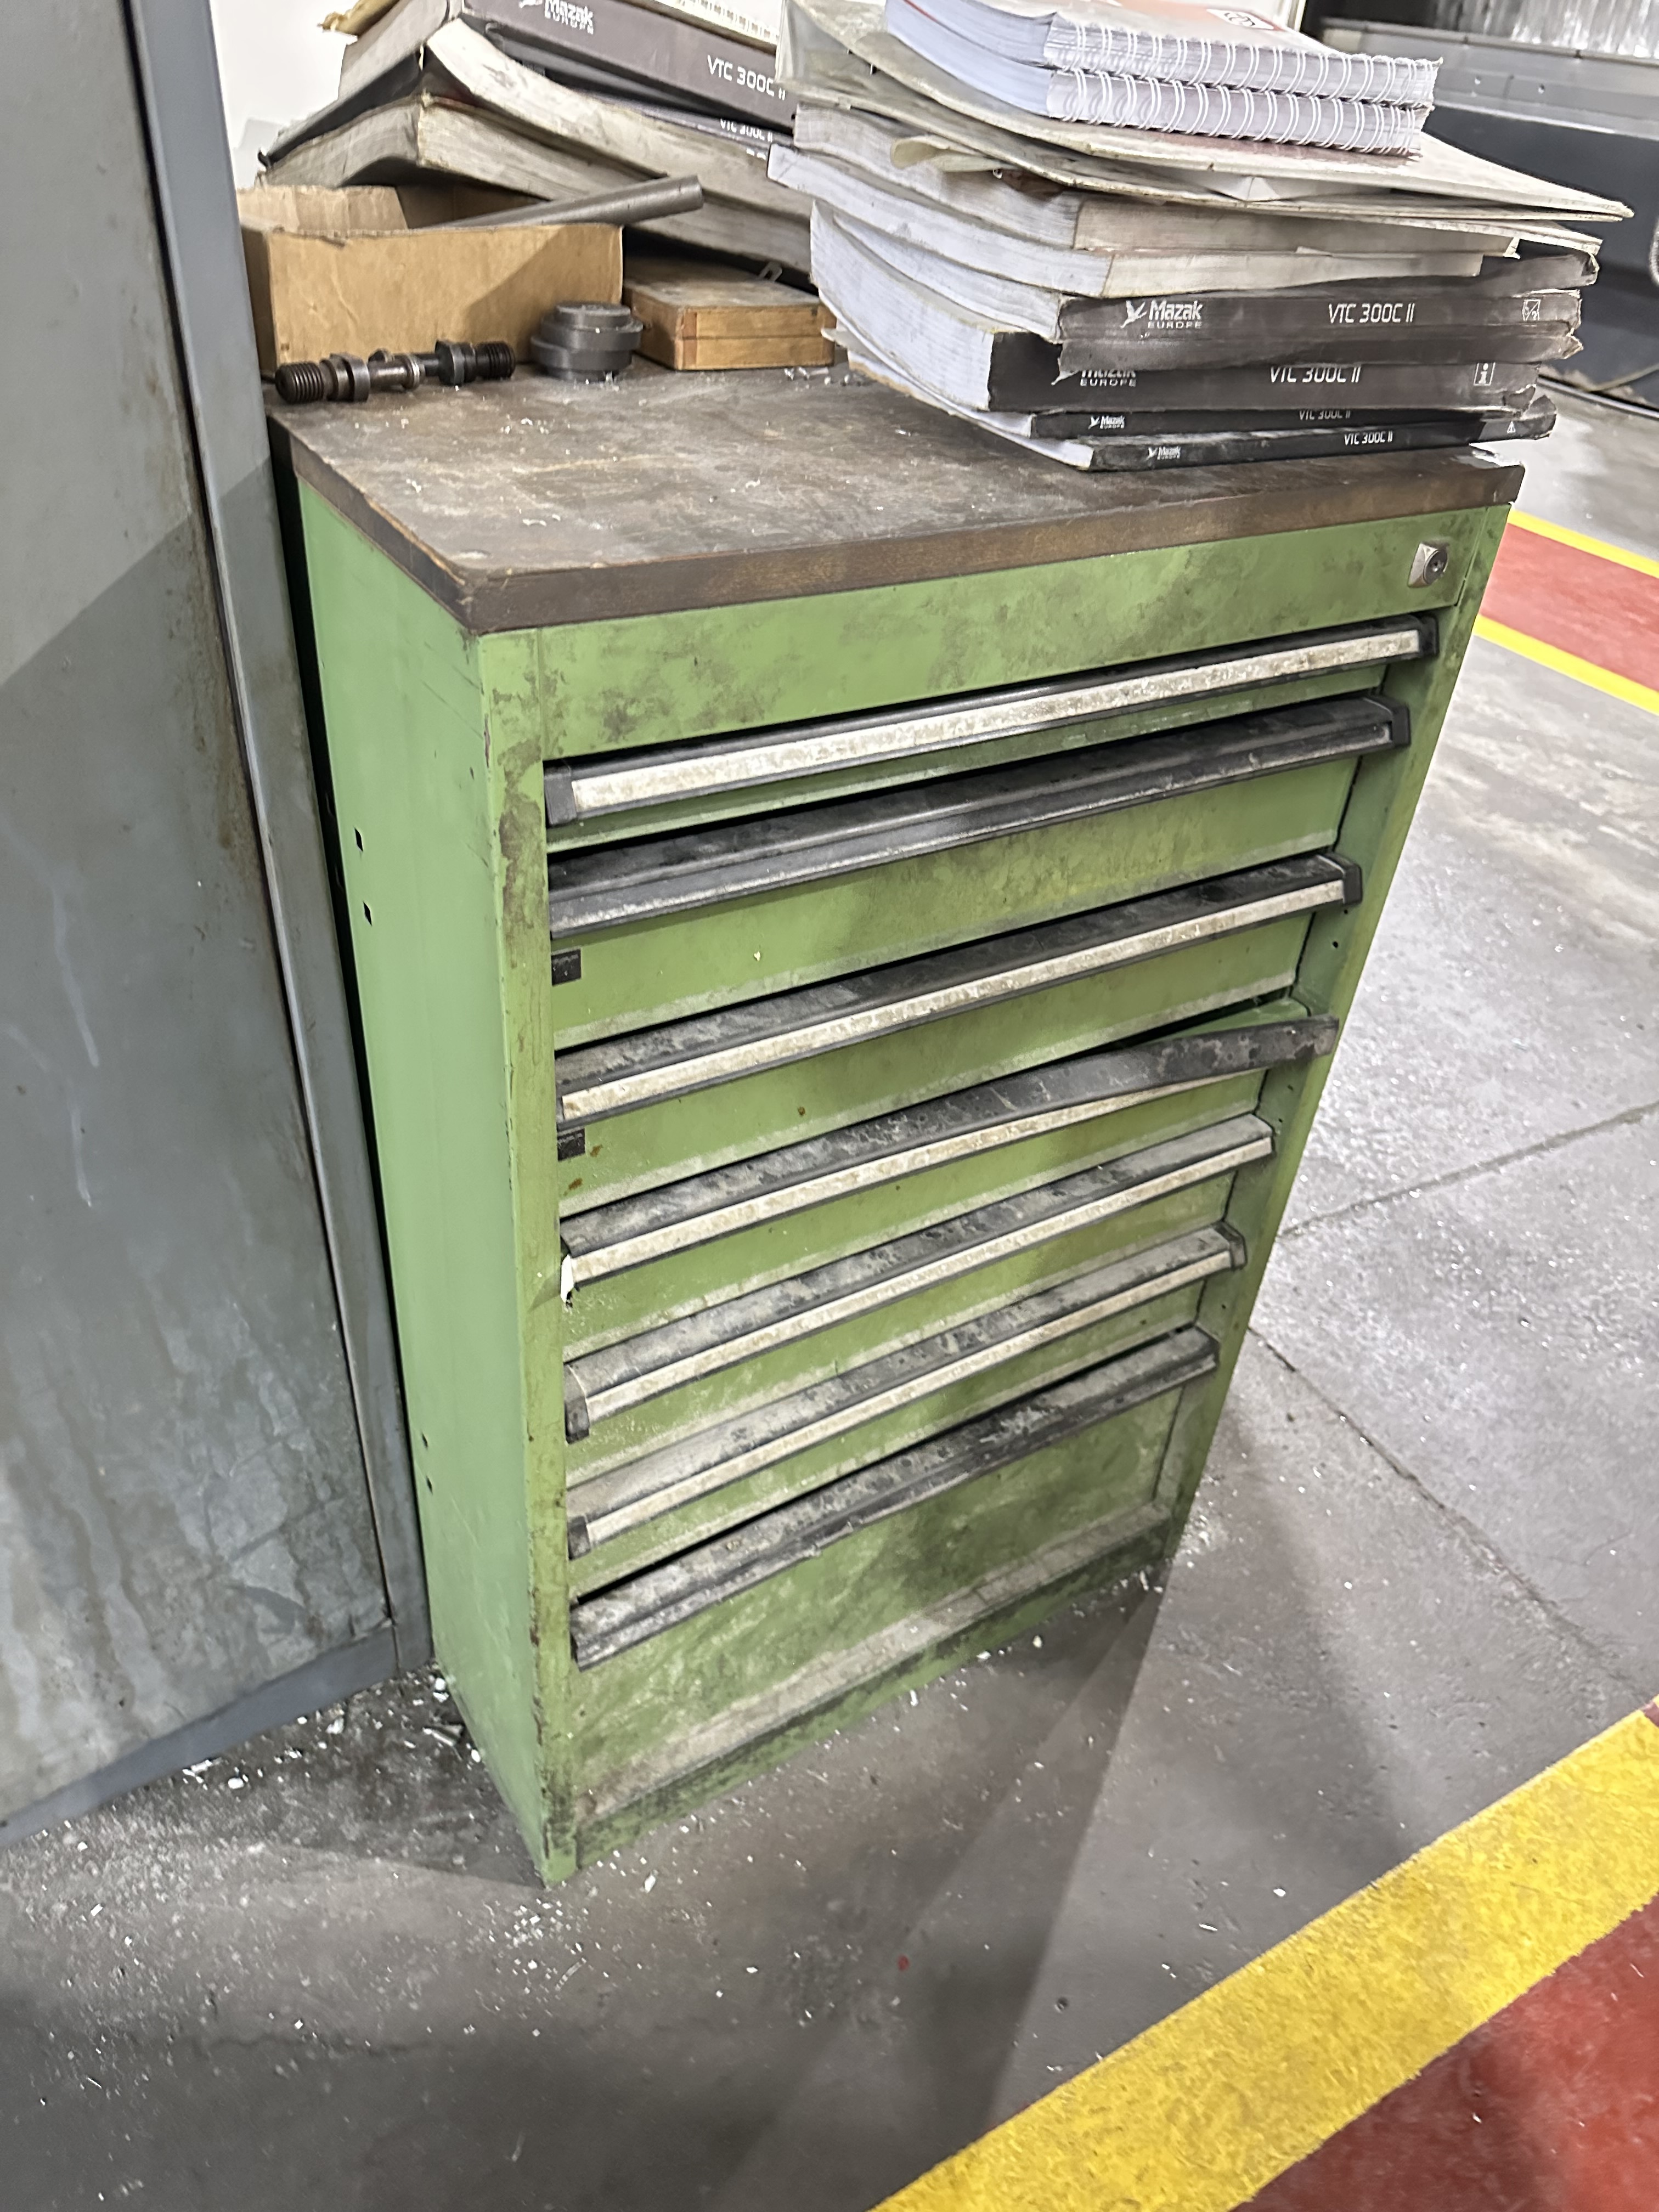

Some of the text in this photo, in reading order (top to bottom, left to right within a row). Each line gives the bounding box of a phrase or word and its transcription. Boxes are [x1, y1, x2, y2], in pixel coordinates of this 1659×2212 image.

[707, 54, 733, 82] VTC
[737, 66, 775, 97] 300C
[1149, 300, 1203, 320] Mazak
[1328, 303, 1415, 324] VTC 300C II
[1148, 321, 1203, 329] EUROPE
[1080, 378, 1136, 387] EUROPE
[1344, 433, 1359, 445] VTC
[1362, 431, 1386, 444] 300C
